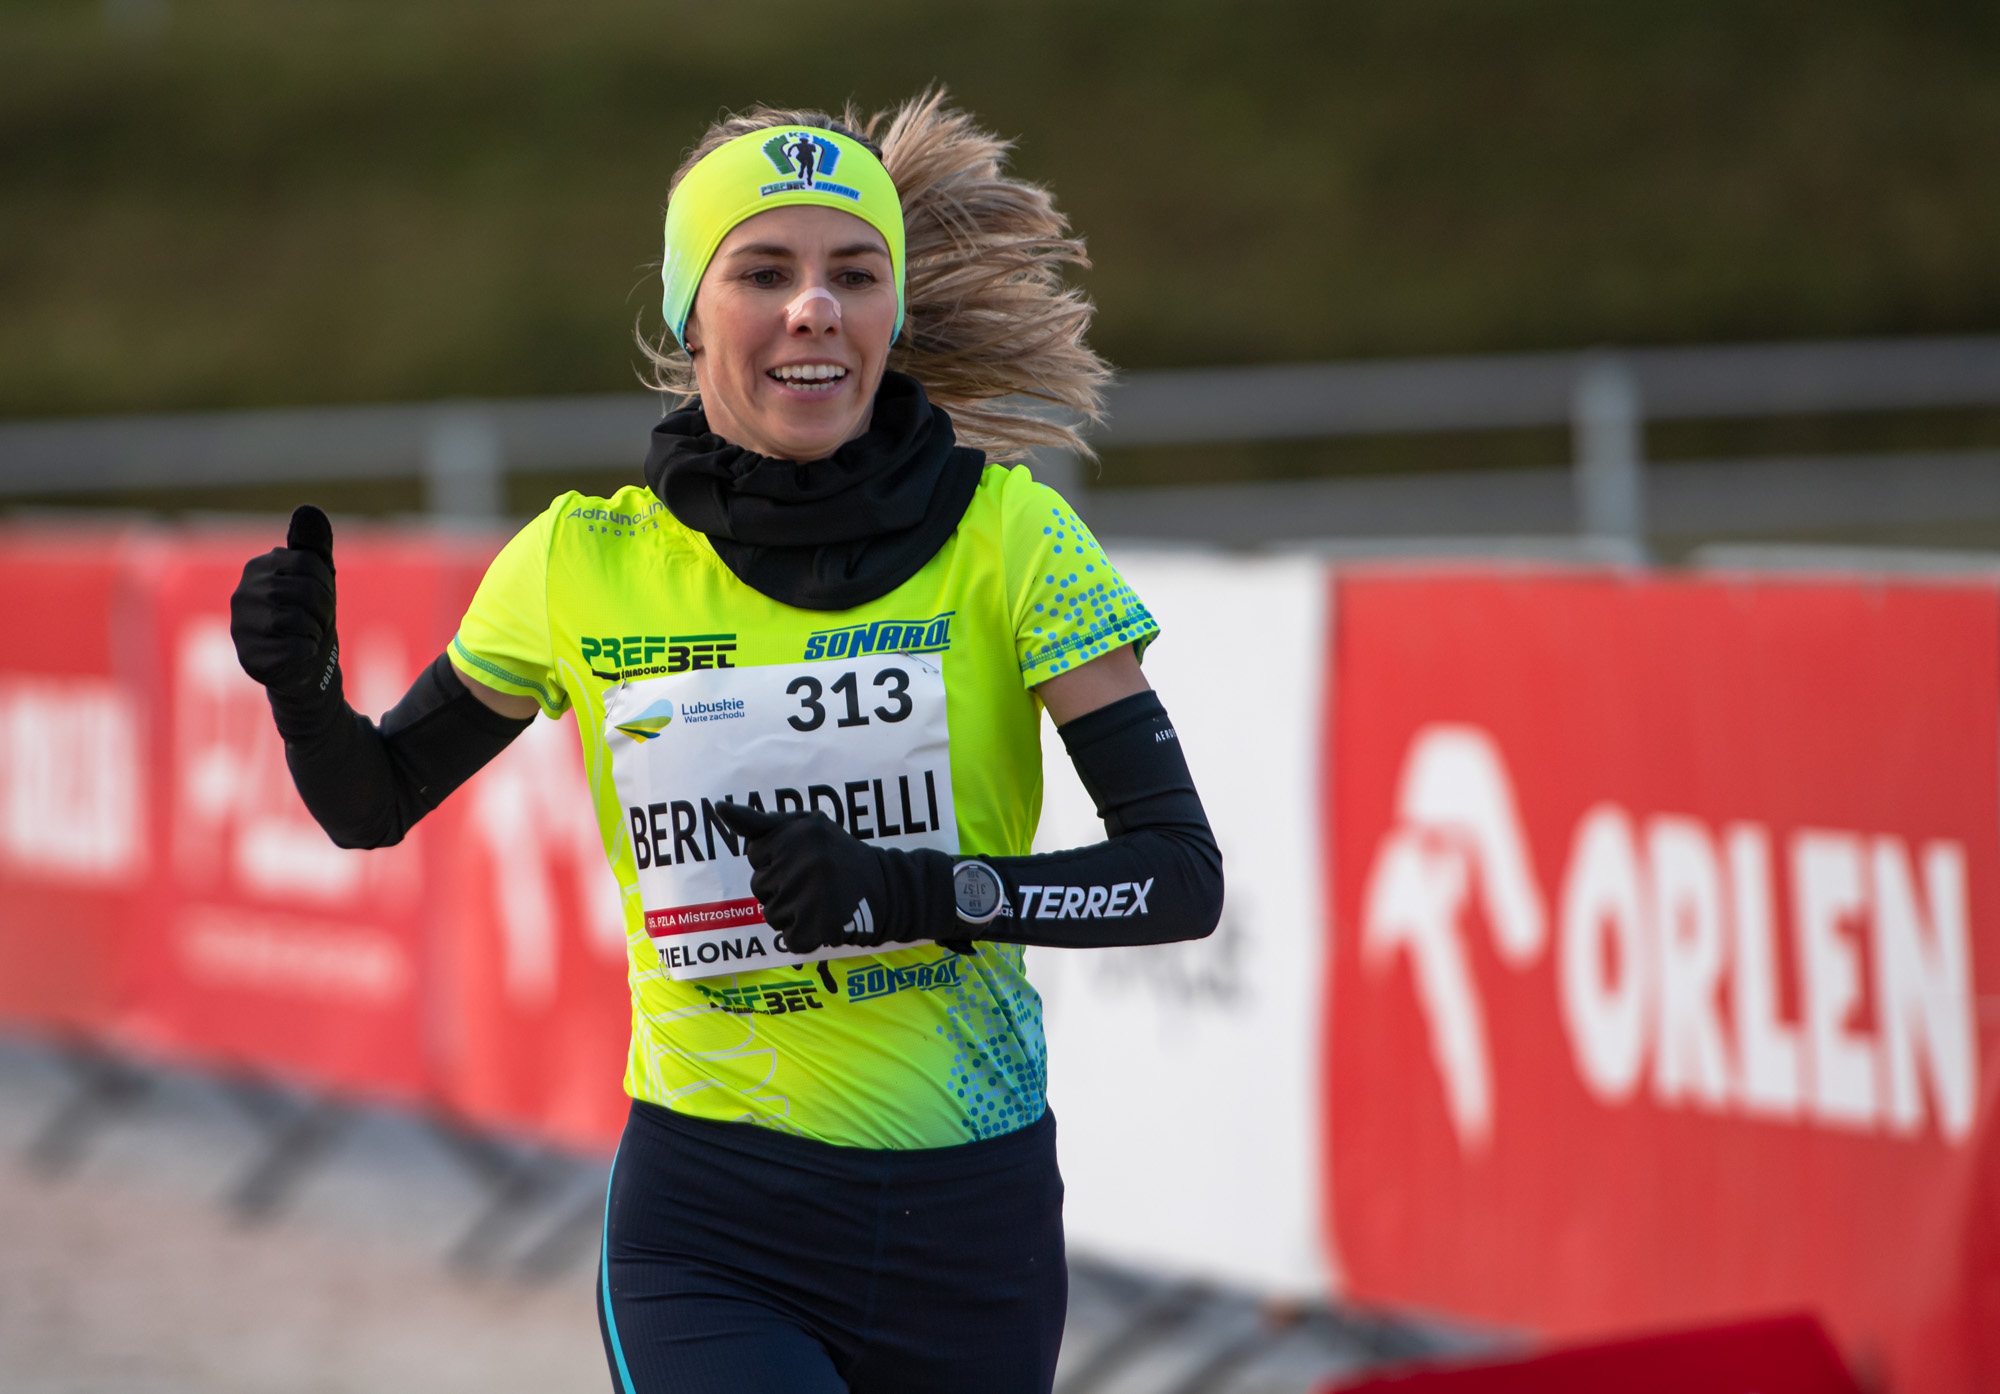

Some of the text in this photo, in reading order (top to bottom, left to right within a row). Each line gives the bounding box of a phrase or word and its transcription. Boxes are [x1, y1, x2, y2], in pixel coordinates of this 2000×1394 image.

[588, 521, 658, 536] SPORTS
[804, 616, 953, 660] SONAROL
[681, 699, 744, 715] Lubuskie
[786, 667, 913, 732] 313
[684, 710, 745, 724] Warte zachodu
[1018, 877, 1154, 919] TERREX
[657, 914, 677, 927] PZLA
[678, 904, 754, 924] Mistrzostwa
[1560, 802, 1974, 1146] ORLEN
